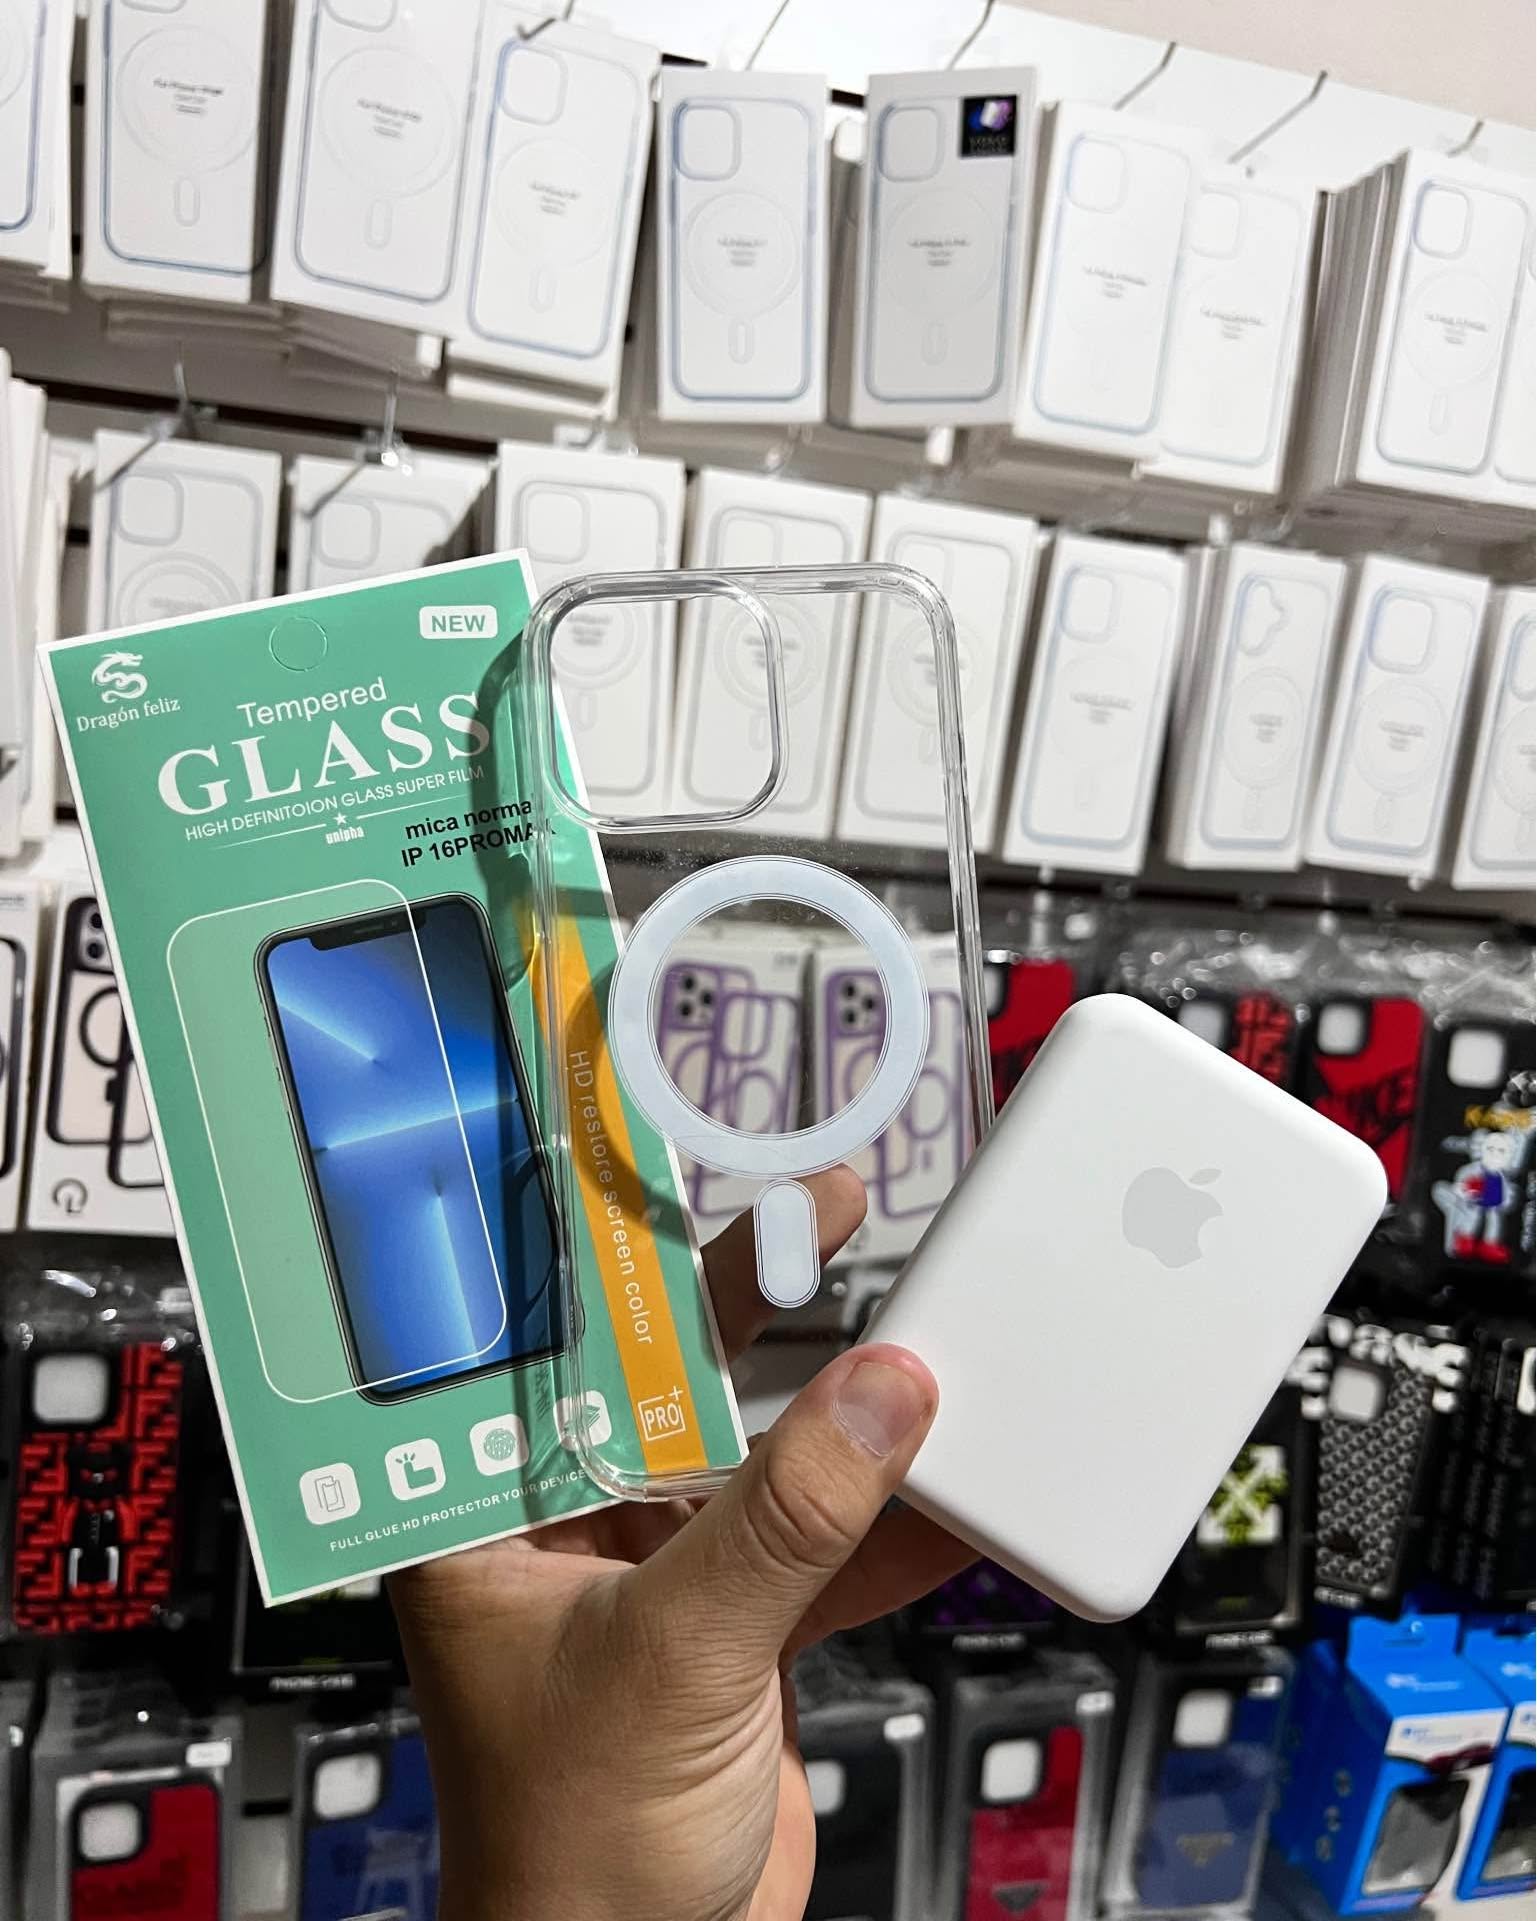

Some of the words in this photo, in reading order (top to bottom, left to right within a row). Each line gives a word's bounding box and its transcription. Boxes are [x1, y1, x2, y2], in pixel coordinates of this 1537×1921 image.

[431, 614, 486, 633] NEW
[76, 706, 140, 732] Dragón
[143, 698, 181, 716] feliz
[236, 676, 388, 728] Tempered
[158, 691, 490, 815] GLASS
[185, 818, 230, 841] HIGH
[231, 795, 339, 831] DEFINITOION
[340, 784, 394, 807] GLASS
[396, 772, 446, 796] SUPER
[448, 764, 485, 785] FILM
[405, 816, 459, 840] mica
[463, 800, 534, 827] norma
[401, 846, 423, 867] IP
[569, 1050, 594, 1088] HD
[578, 1094, 614, 1184] restore
[603, 1190, 636, 1276] screen
[625, 1282, 653, 1345] color
[329, 1537, 363, 1552] FULL
[364, 1524, 401, 1542] GLUE
[402, 1518, 420, 1531] HD
[422, 1493, 502, 1525] PROTECTOR
[501, 1483, 539, 1502] YOUR
